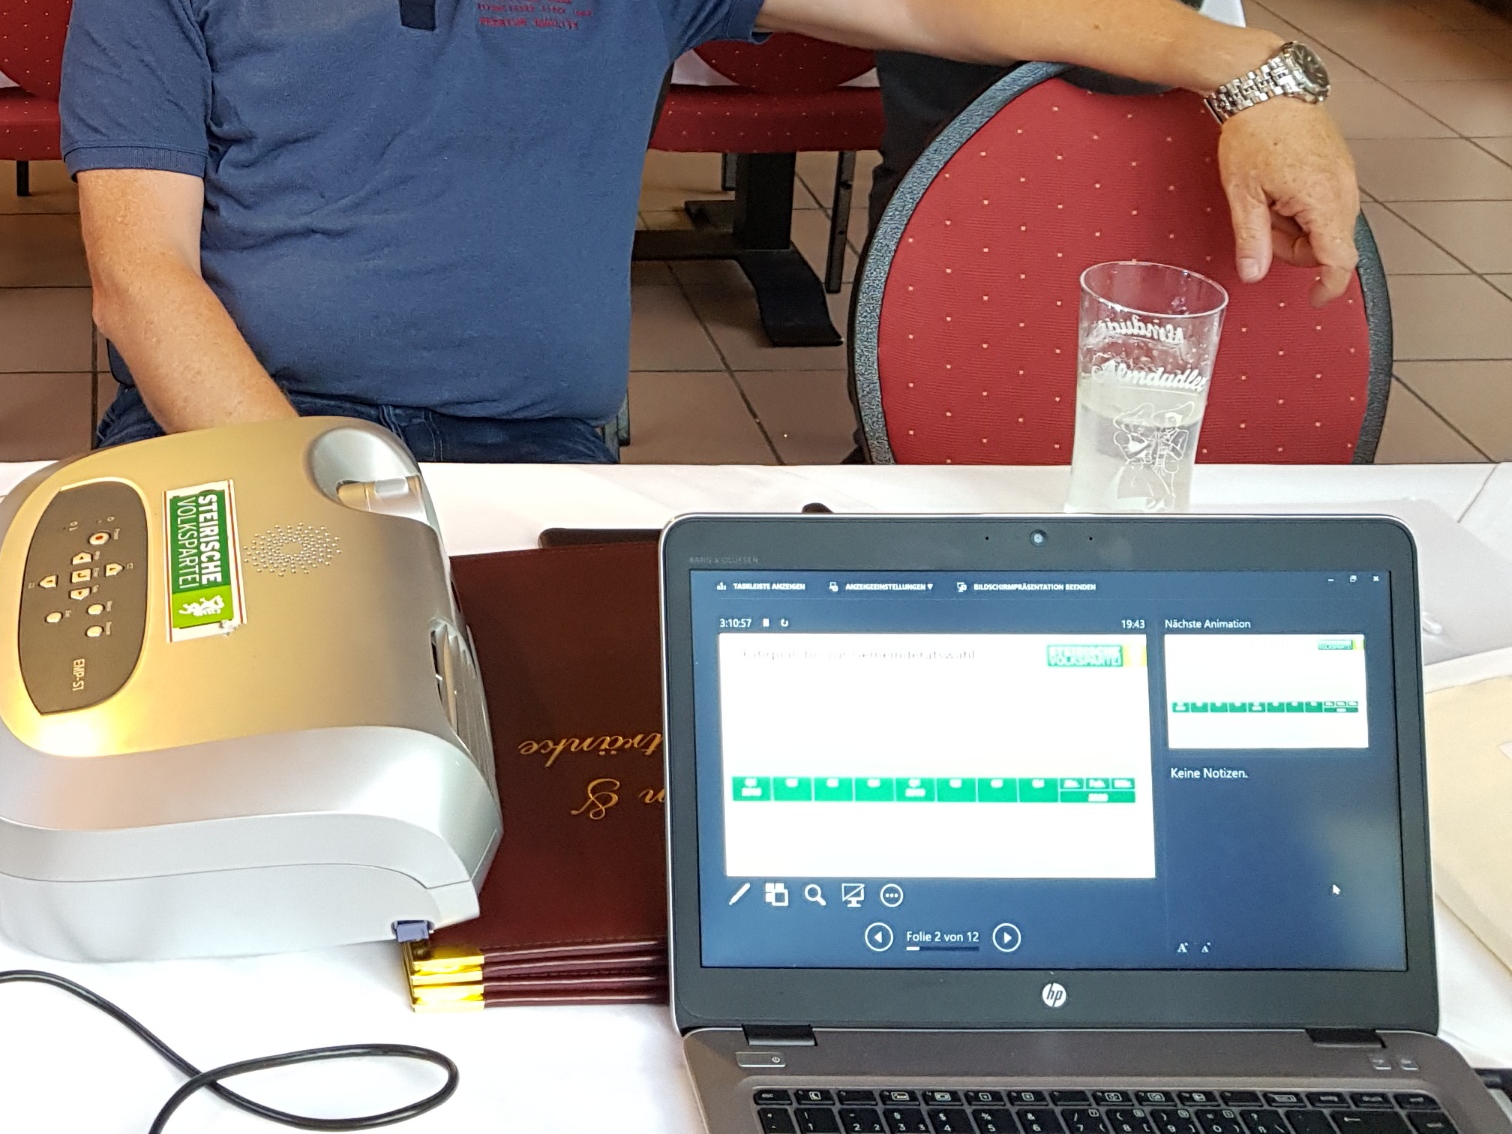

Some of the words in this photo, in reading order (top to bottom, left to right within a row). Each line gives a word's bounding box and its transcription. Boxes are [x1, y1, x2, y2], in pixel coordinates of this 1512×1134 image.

[176, 496, 201, 589] VOLKSPARTEI
[197, 494, 223, 585] STEIRISCHE
[719, 618, 752, 628] 3:10:57
[1121, 619, 1146, 629] 19:43
[1165, 618, 1202, 629] Nächste
[1204, 619, 1251, 629] Animation
[1170, 768, 1200, 779] Keine
[1203, 768, 1249, 779] Notizen.
[906, 931, 932, 942] Folie
[934, 932, 941, 942] 2
[943, 934, 964, 942] von
[966, 932, 979, 942] 12
